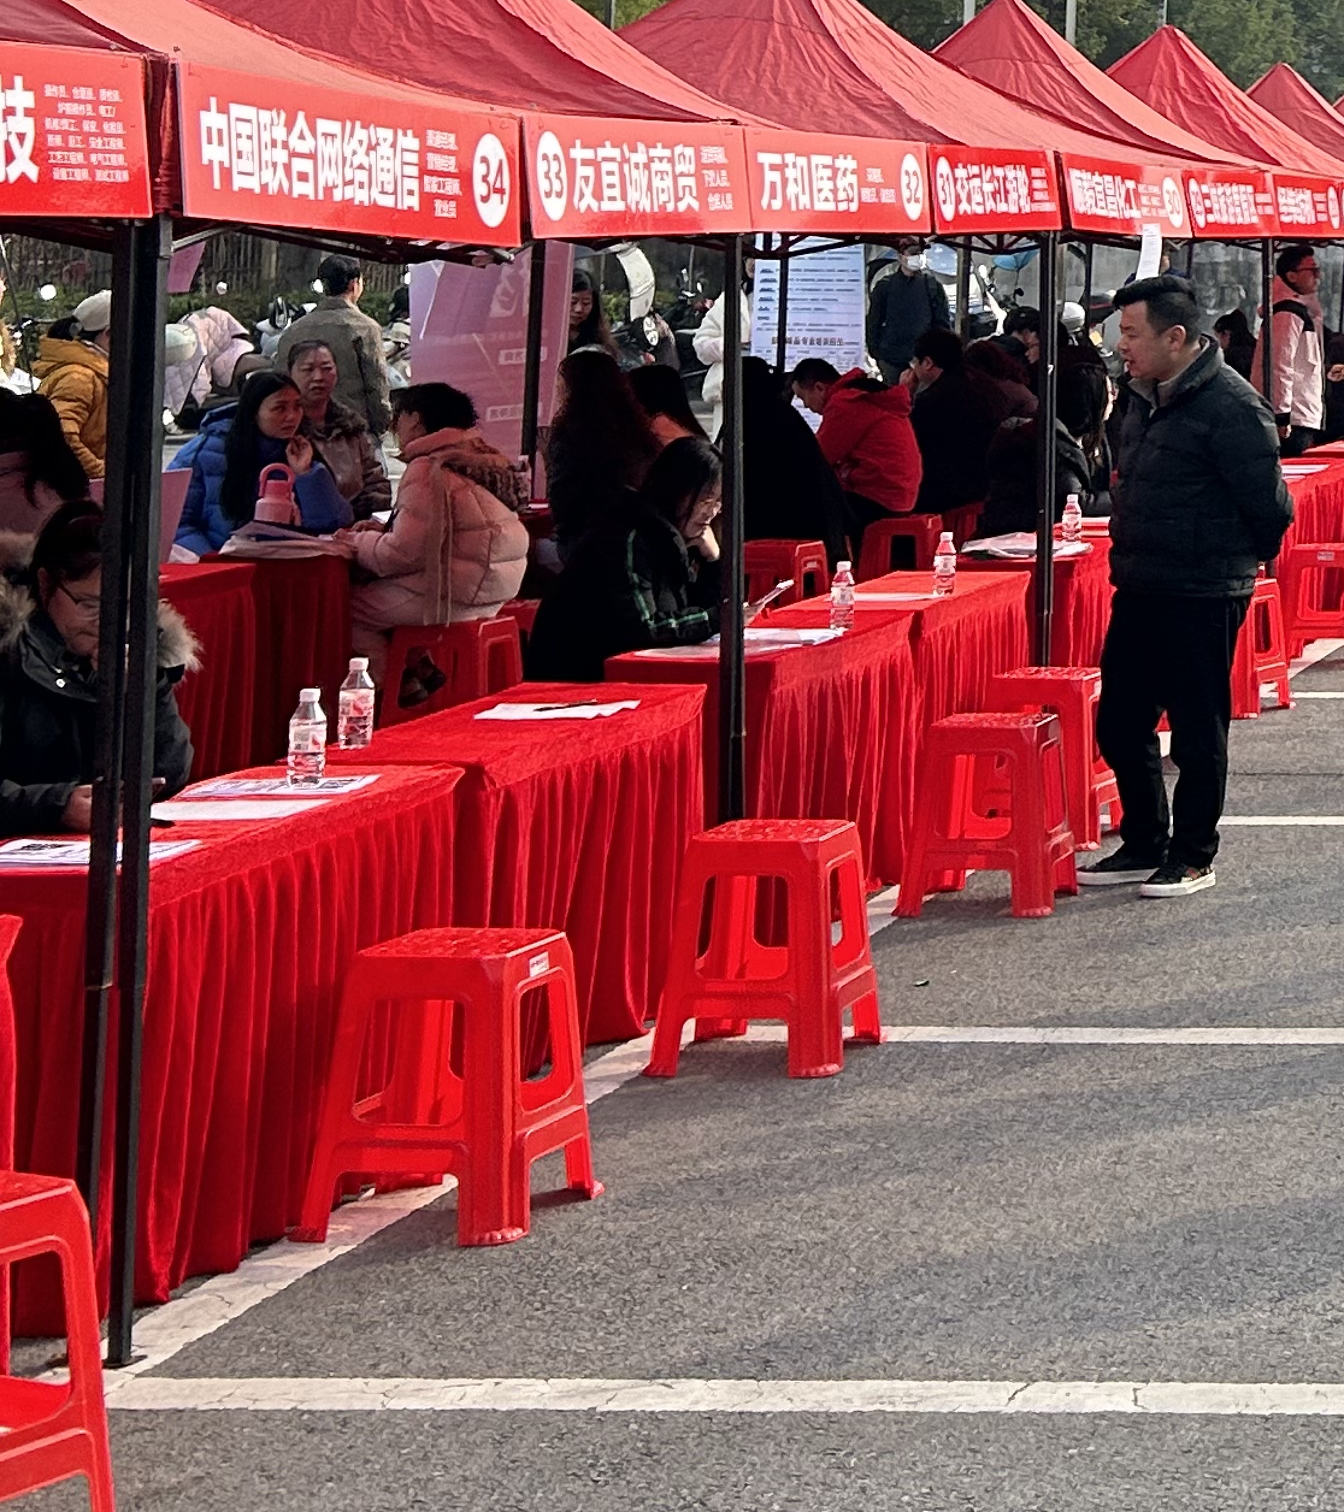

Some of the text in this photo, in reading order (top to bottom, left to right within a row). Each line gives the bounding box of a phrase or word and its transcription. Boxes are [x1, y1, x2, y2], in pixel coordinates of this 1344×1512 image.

[200, 97, 420, 212] 中国联合网络通信
[480, 155, 508, 207] 34
[541, 152, 564, 199] 33
[569, 140, 699, 214] 友宜诚商贸
[757, 152, 860, 213] 万和医药
[904, 169, 921, 205] 32
[939, 172, 953, 206] 31
